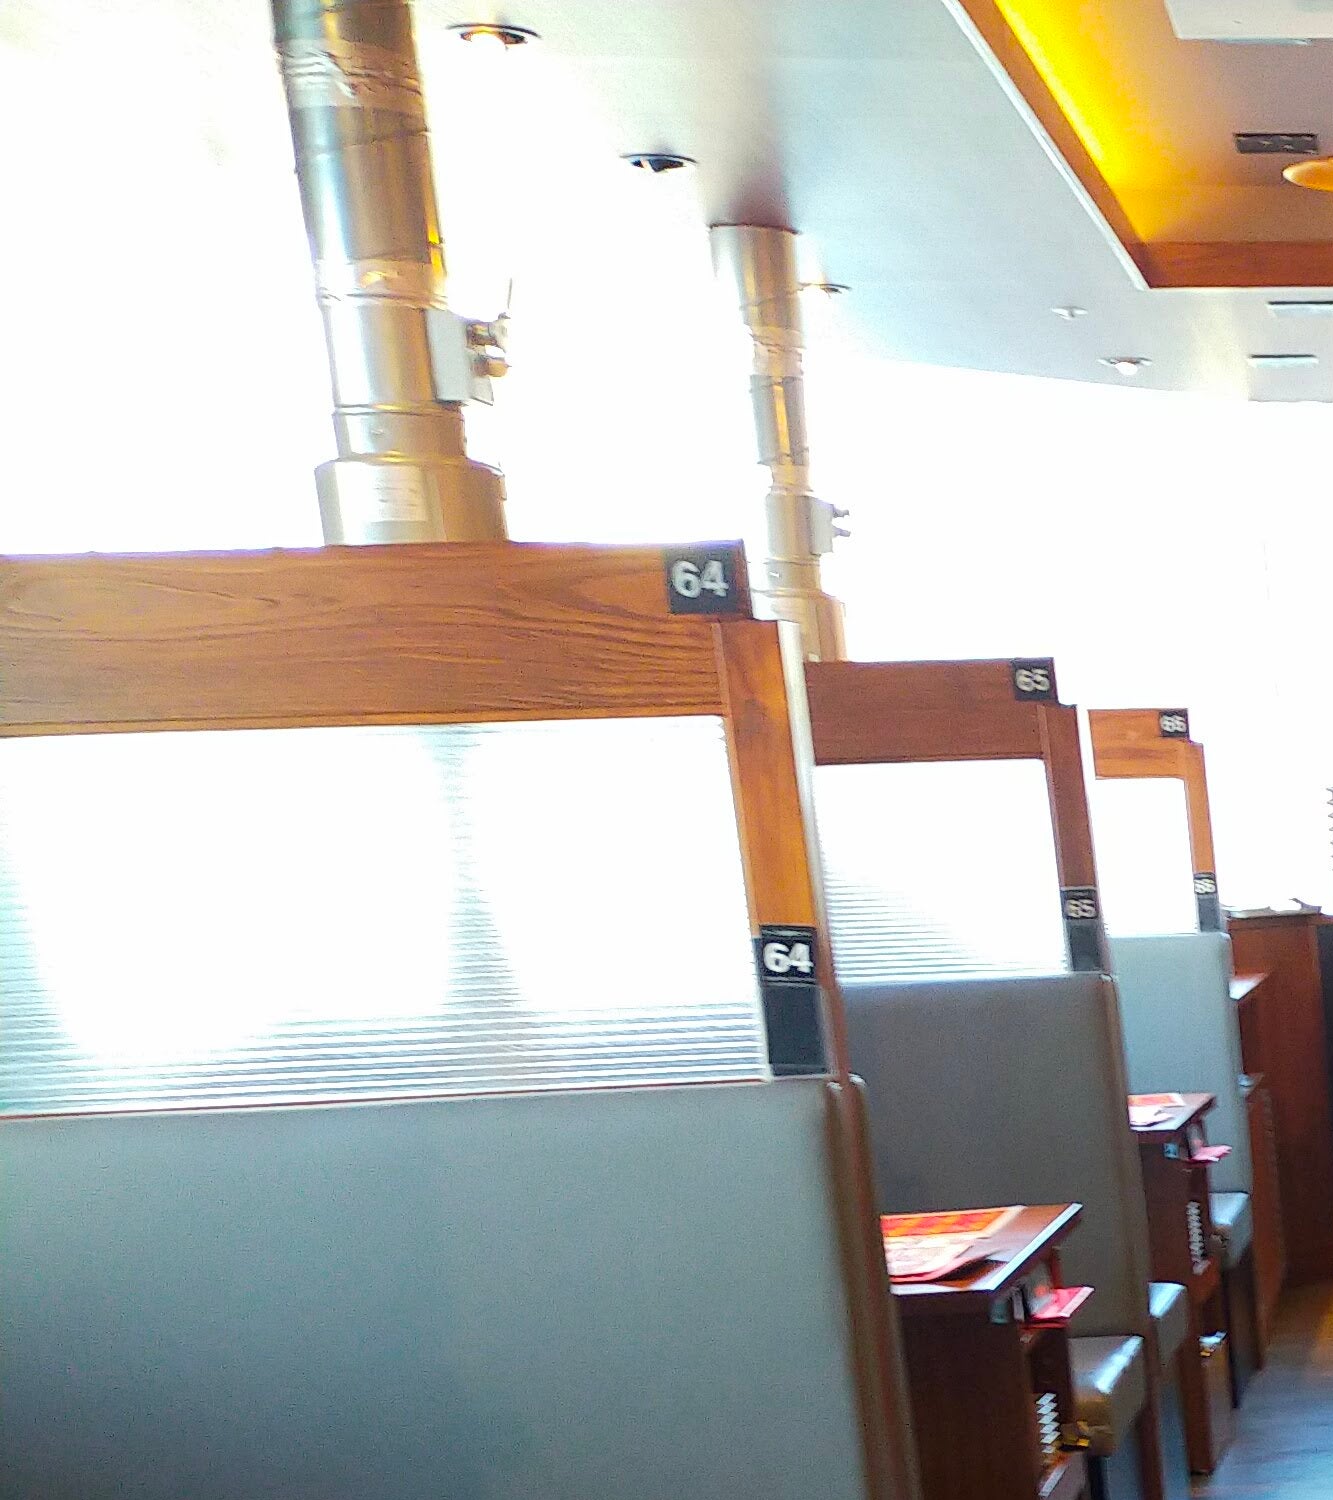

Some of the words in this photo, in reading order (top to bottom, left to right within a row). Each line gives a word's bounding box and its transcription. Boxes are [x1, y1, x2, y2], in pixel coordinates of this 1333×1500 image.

[671, 560, 729, 599] 64
[1015, 668, 1050, 692] 65
[1066, 898, 1097, 919] 65
[763, 942, 814, 978] 64
